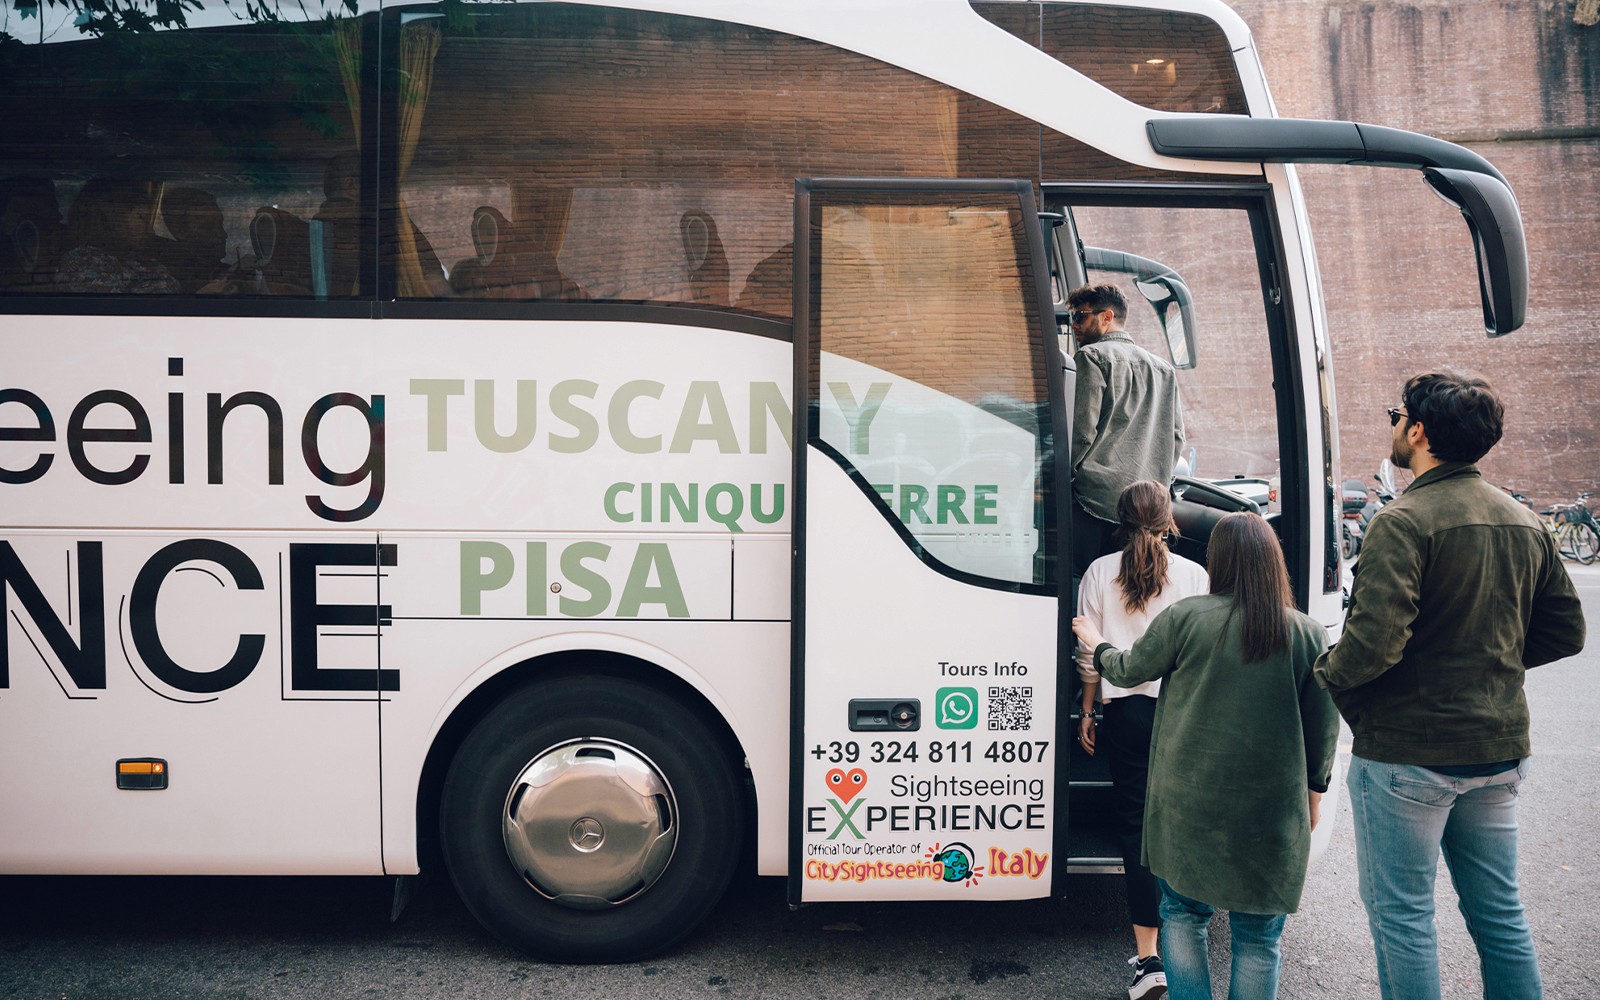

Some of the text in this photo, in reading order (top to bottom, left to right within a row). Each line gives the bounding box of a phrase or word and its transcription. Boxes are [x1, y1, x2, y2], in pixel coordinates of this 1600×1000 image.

[409, 378, 893, 456] TUSCANY
[0, 357, 386, 522] eeing
[603, 481, 785, 533] CINQU
[460, 540, 691, 618] PISA
[0, 538, 401, 694] NCE
[937, 661, 1028, 677] Tours Info
[811, 741, 1049, 763] +39 324 811 4807
[890, 774, 1044, 802] Sightseeing
[807, 798, 1046, 841] EXPERIENCE
[807, 842, 921, 856] Official Tour Operator of
[989, 846, 1048, 880] Italy
